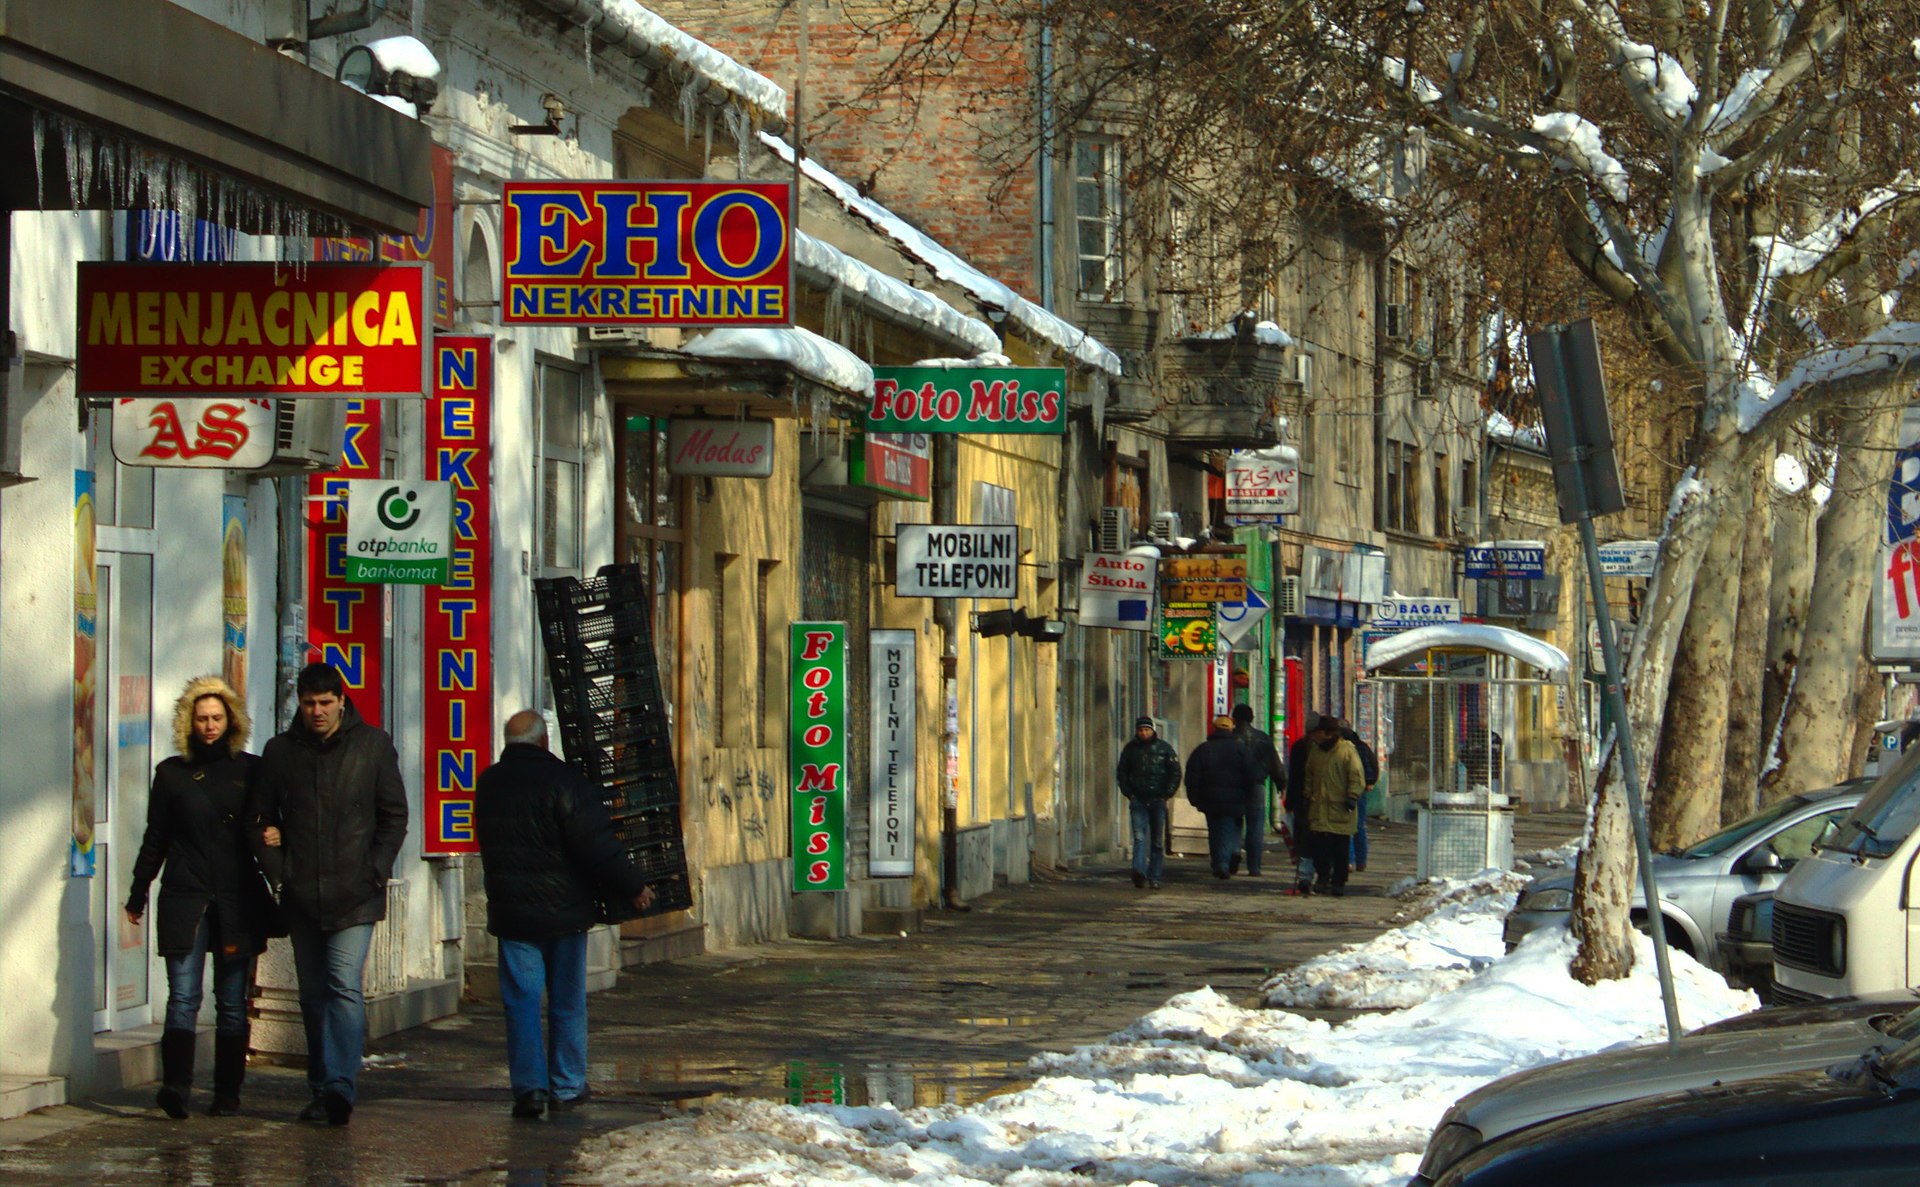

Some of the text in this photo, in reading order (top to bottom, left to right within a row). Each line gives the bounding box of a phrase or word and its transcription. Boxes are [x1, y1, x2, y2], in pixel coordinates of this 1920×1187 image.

[507, 189, 787, 282] EHO
[88, 273, 417, 347] MENJAČNICA
[510, 284, 784, 319] NEKRETNINE
[141, 354, 364, 386] EXCHANGE
[869, 378, 1060, 423] Foto Miss
[139, 402, 250, 461] AS
[1228, 465, 1296, 487] TAŠNE
[927, 533, 1011, 558] MOBILNI
[1468, 549, 1541, 562] ACADEMY
[357, 563, 438, 580] bankomat
[916, 562, 1011, 591] TELEFONI
[1093, 556, 1145, 571] Auto
[1088, 571, 1147, 590] Škola
[1400, 604, 1451, 614] BAGAT
[887, 649, 900, 857] MOBILNI TELEFONI
[1887, 736, 1897, 749] P
[796, 631, 840, 884] Foto Miss
